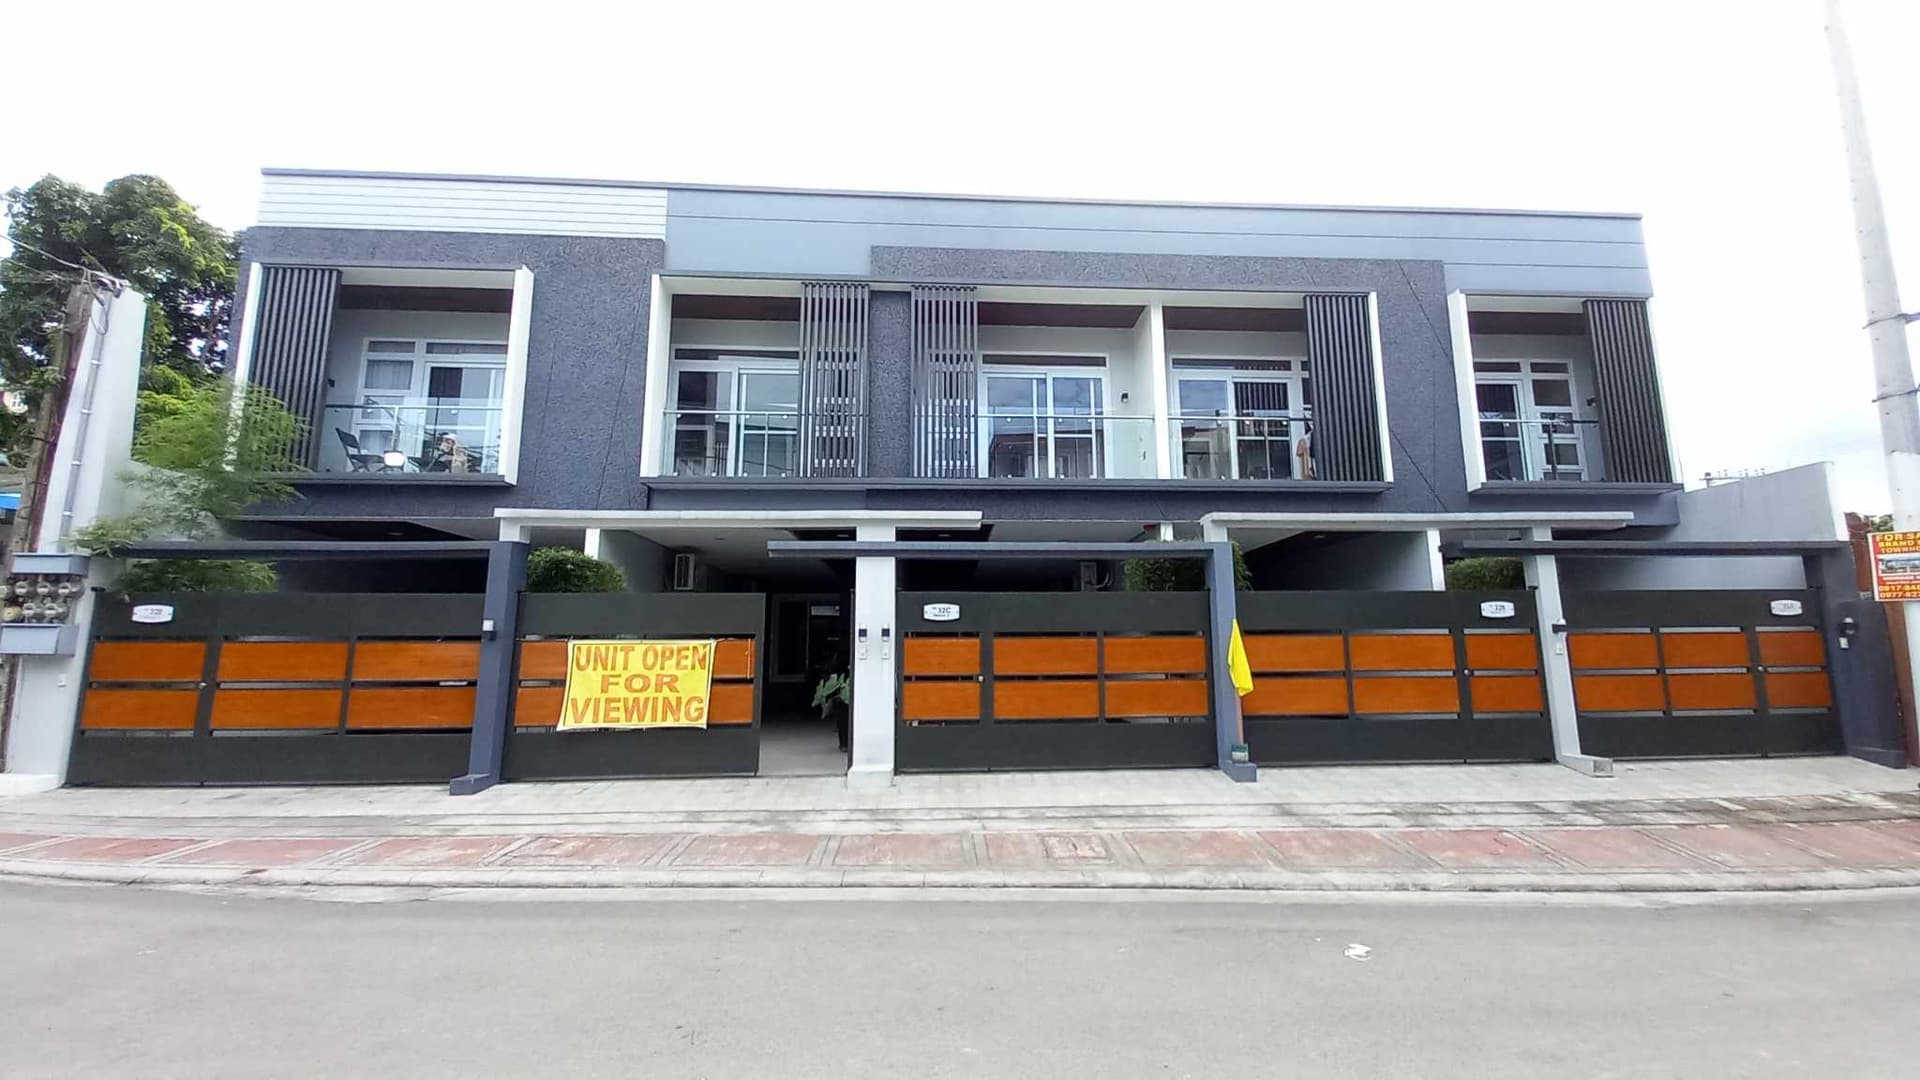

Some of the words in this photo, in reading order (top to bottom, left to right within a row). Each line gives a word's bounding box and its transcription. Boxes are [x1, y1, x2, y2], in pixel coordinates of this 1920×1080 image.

[1876, 533, 1903, 542] FOR
[575, 645, 635, 671] UNIT
[642, 644, 707, 671] OPEN
[600, 673, 680, 694] FOR
[570, 695, 704, 724] VIEWING
